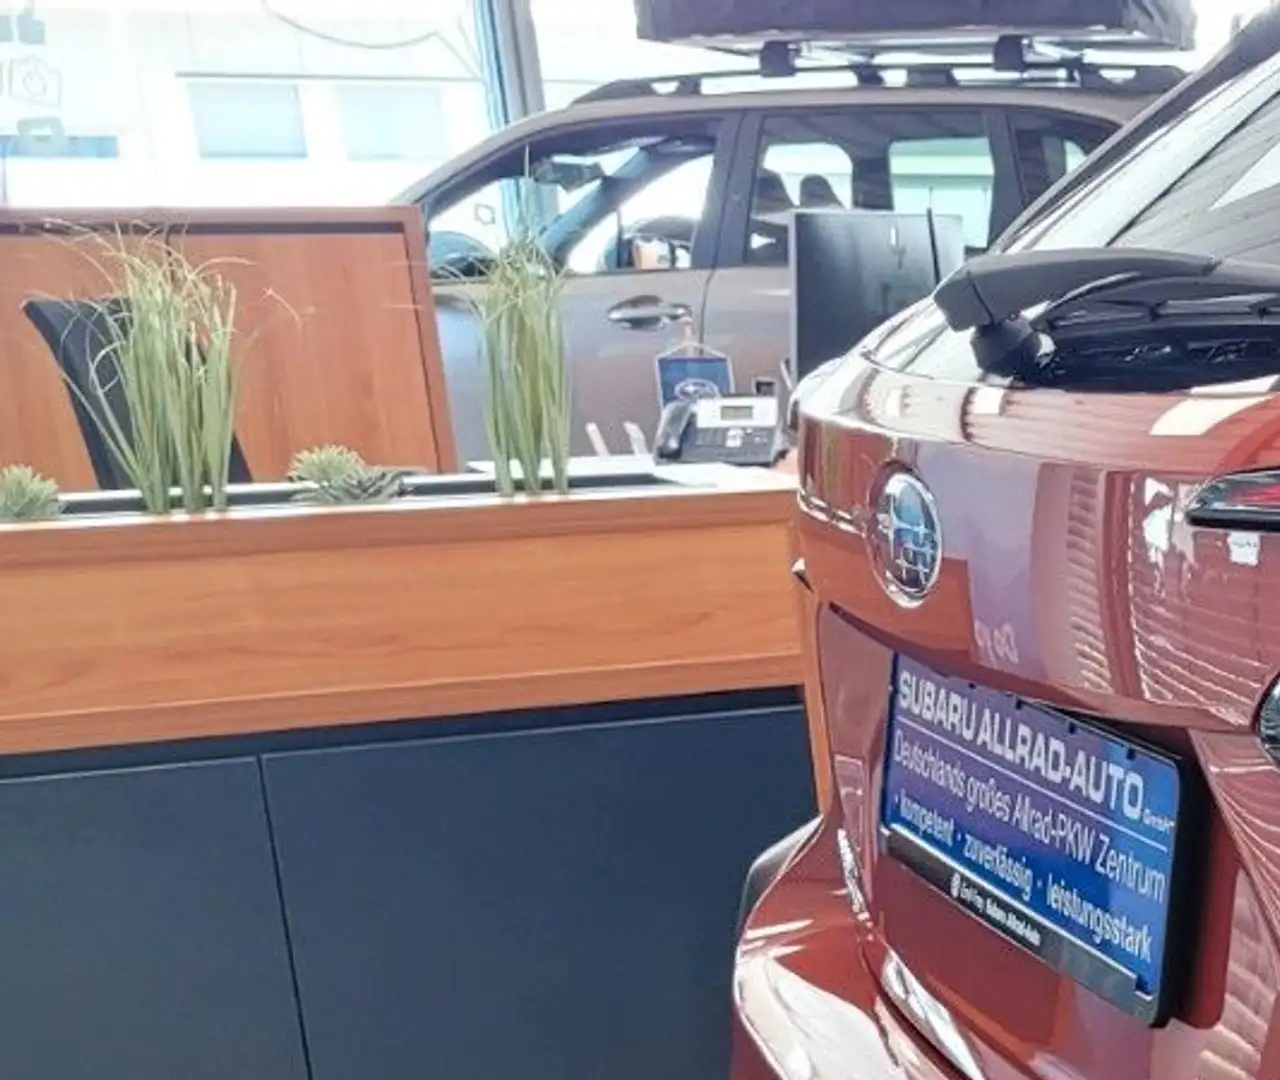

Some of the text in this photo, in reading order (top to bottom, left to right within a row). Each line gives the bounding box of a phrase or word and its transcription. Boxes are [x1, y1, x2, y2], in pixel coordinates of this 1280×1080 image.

[893, 728, 1167, 905] Deutschlands großes Allrad-PKW Zentrum
[900, 669, 977, 742] SUBARU
[977, 708, 1144, 820] ALLRAD-AUTO
[899, 787, 955, 847] kompetent
[962, 831, 1034, 902] zuverlässig
[1046, 872, 1153, 964] leistungsstark
